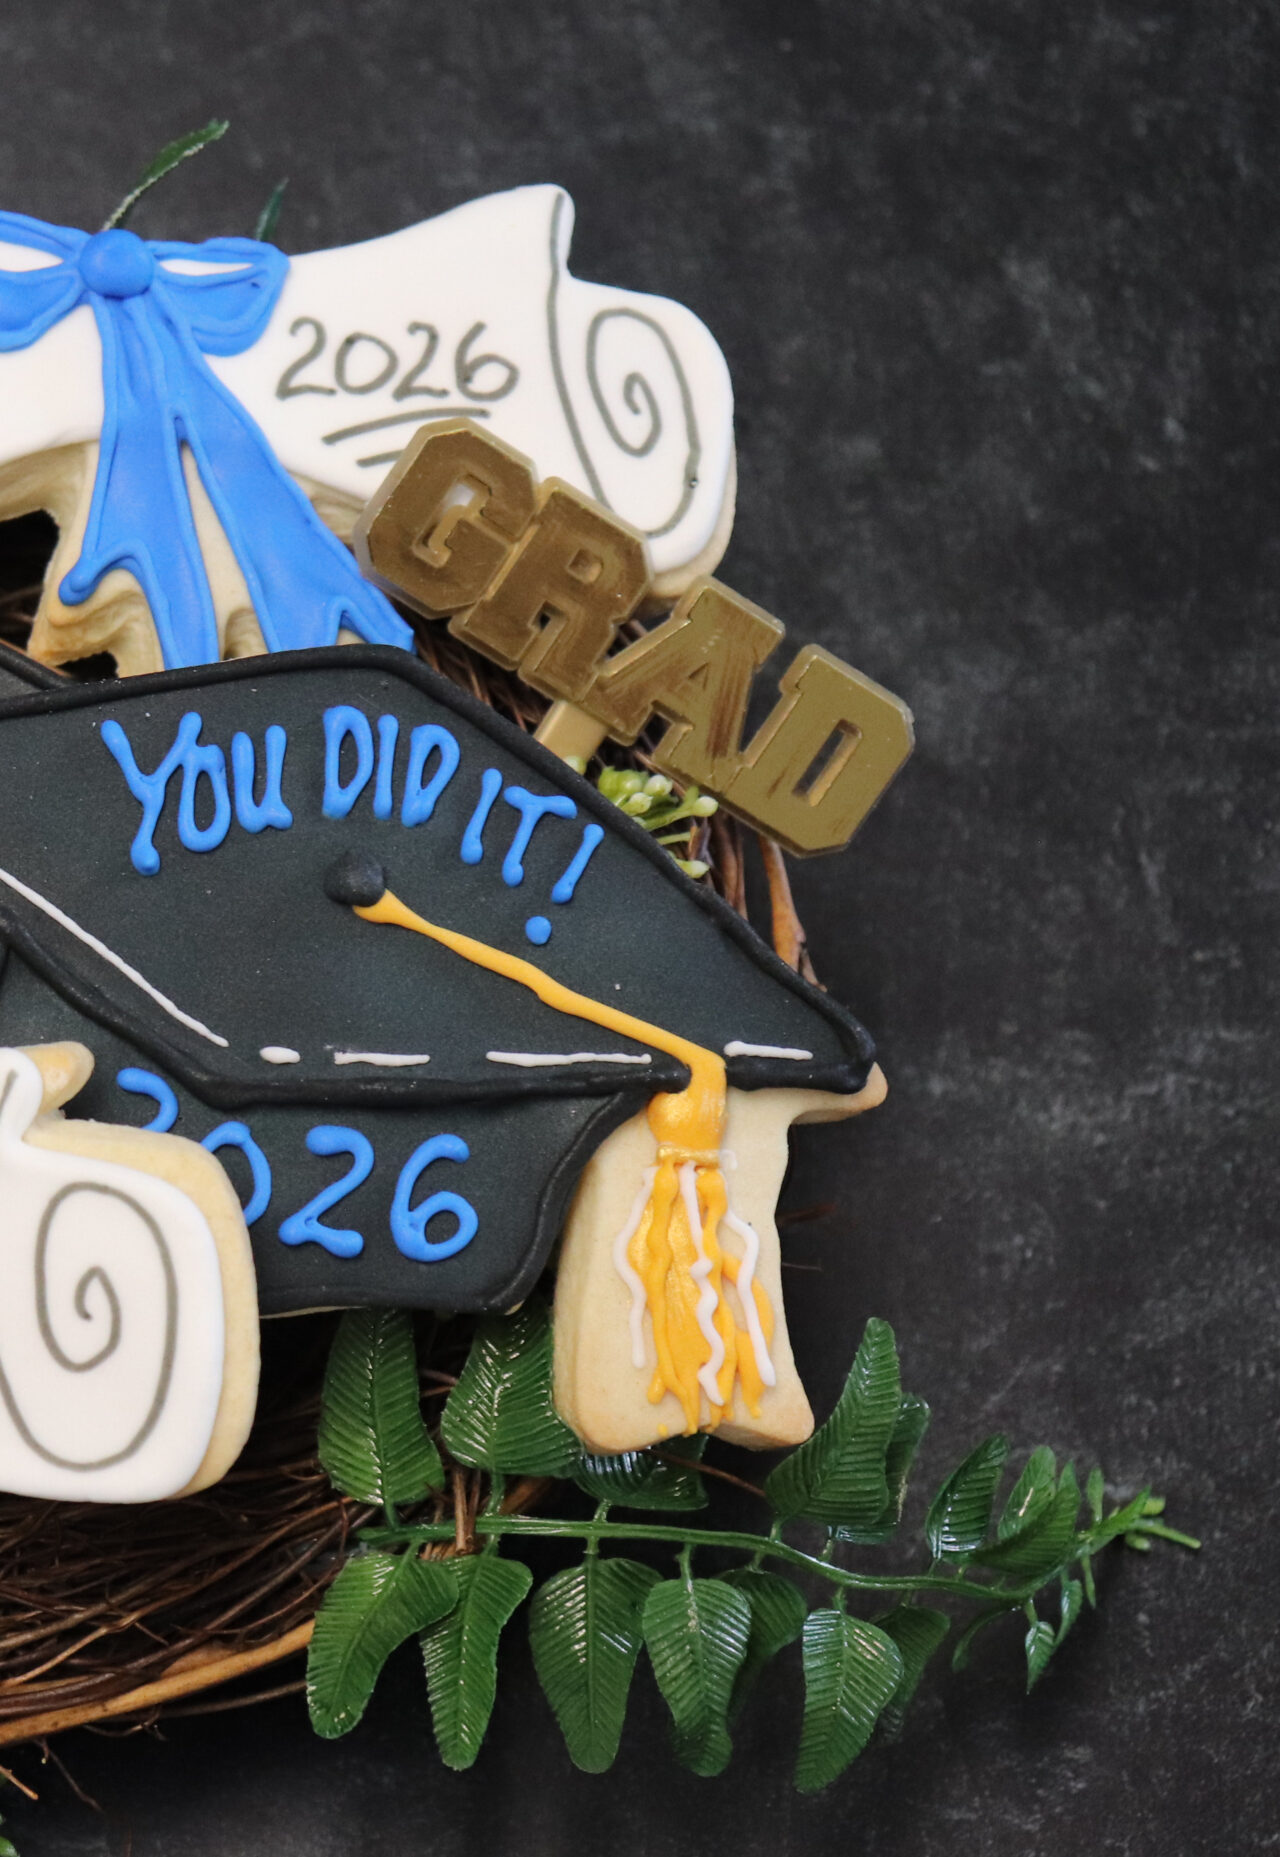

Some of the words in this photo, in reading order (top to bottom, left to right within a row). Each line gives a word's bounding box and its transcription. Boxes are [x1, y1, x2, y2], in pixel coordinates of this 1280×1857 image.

[275, 316, 520, 402] 2026
[352, 415, 916, 860] GRAD
[322, 704, 461, 828] DID
[459, 767, 606, 946] IT!
